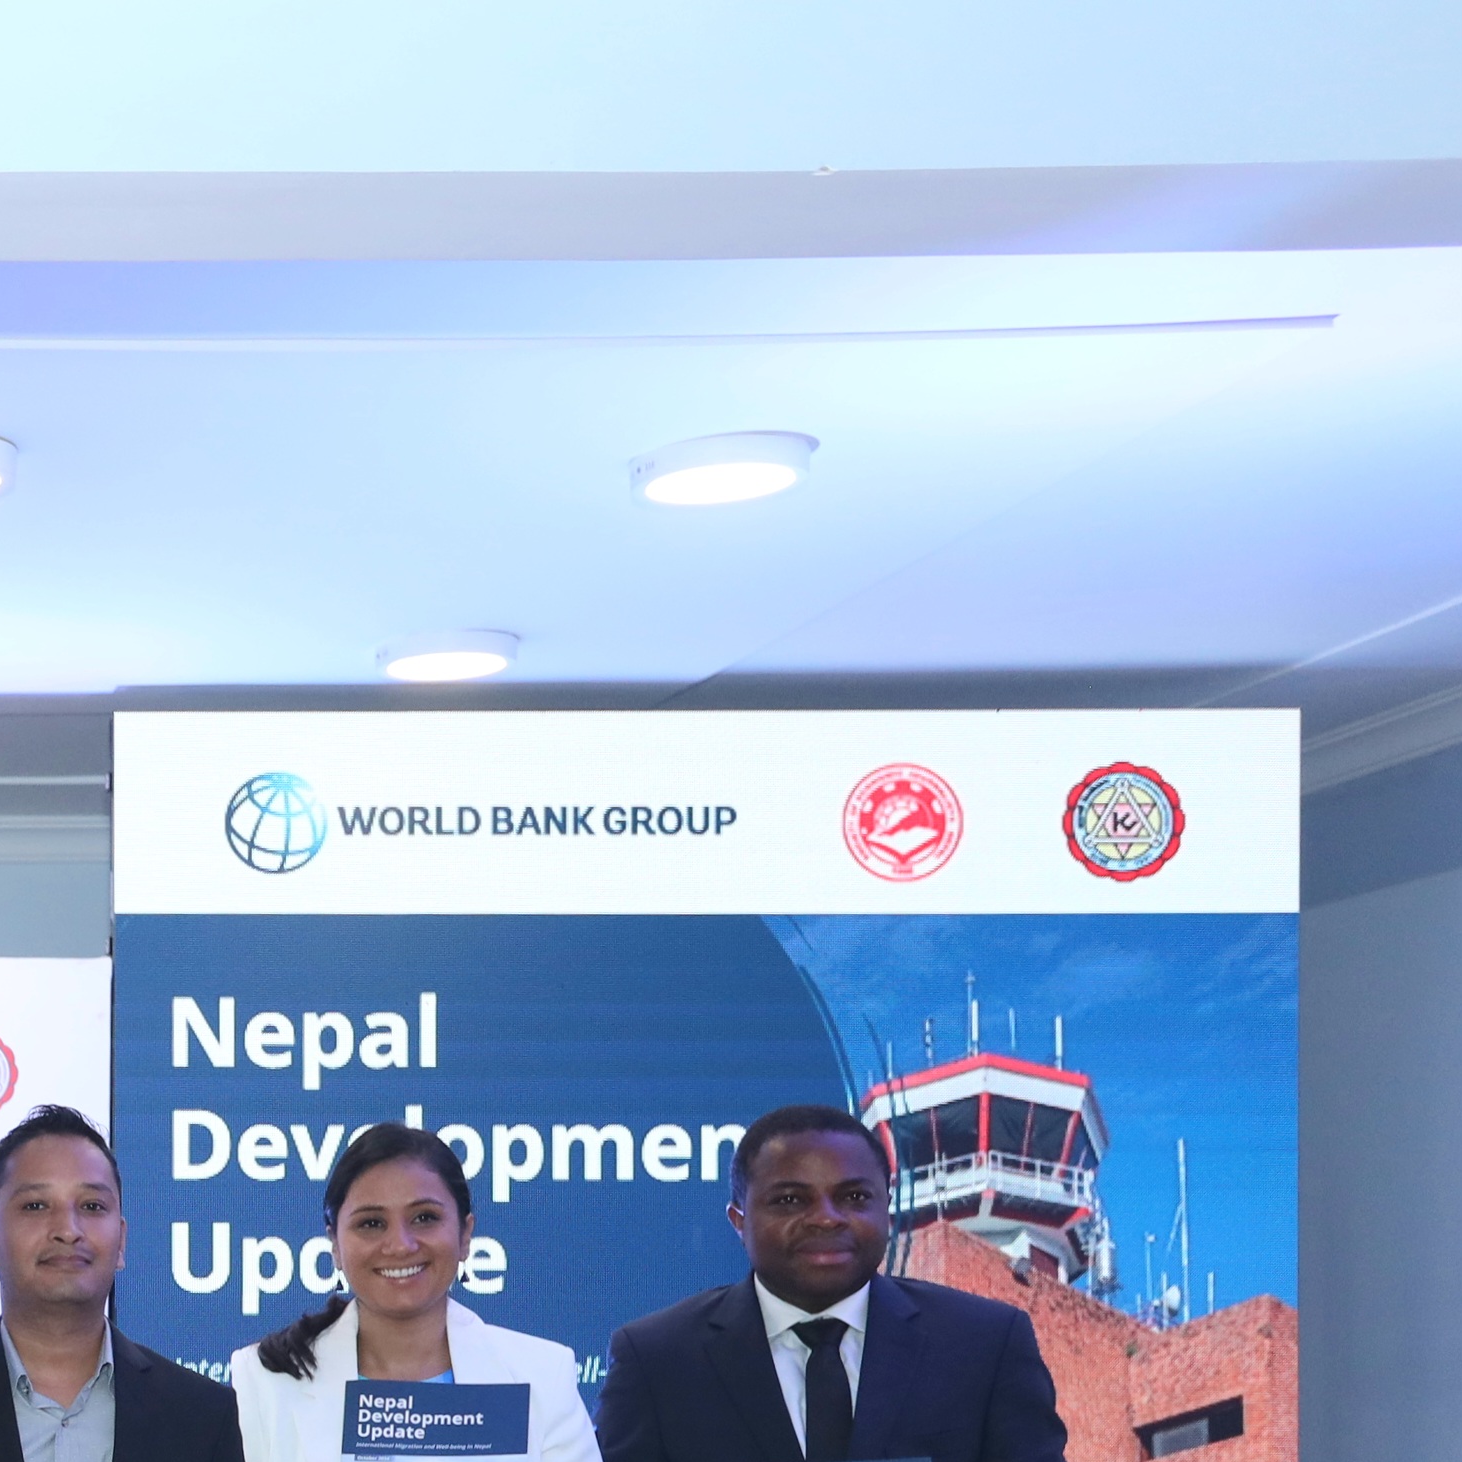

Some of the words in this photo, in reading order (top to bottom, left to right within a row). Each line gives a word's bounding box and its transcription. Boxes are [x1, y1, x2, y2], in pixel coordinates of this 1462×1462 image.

[338, 806, 482, 836] WORLD
[492, 806, 595, 836] BANK
[603, 806, 737, 836] GROUP
[171, 992, 437, 1090] Nepal
[171, 1104, 746, 1203] Devopmen
[359, 1394, 413, 1412] Nepal
[358, 1409, 484, 1427] Development
[357, 1424, 425, 1441] Update
